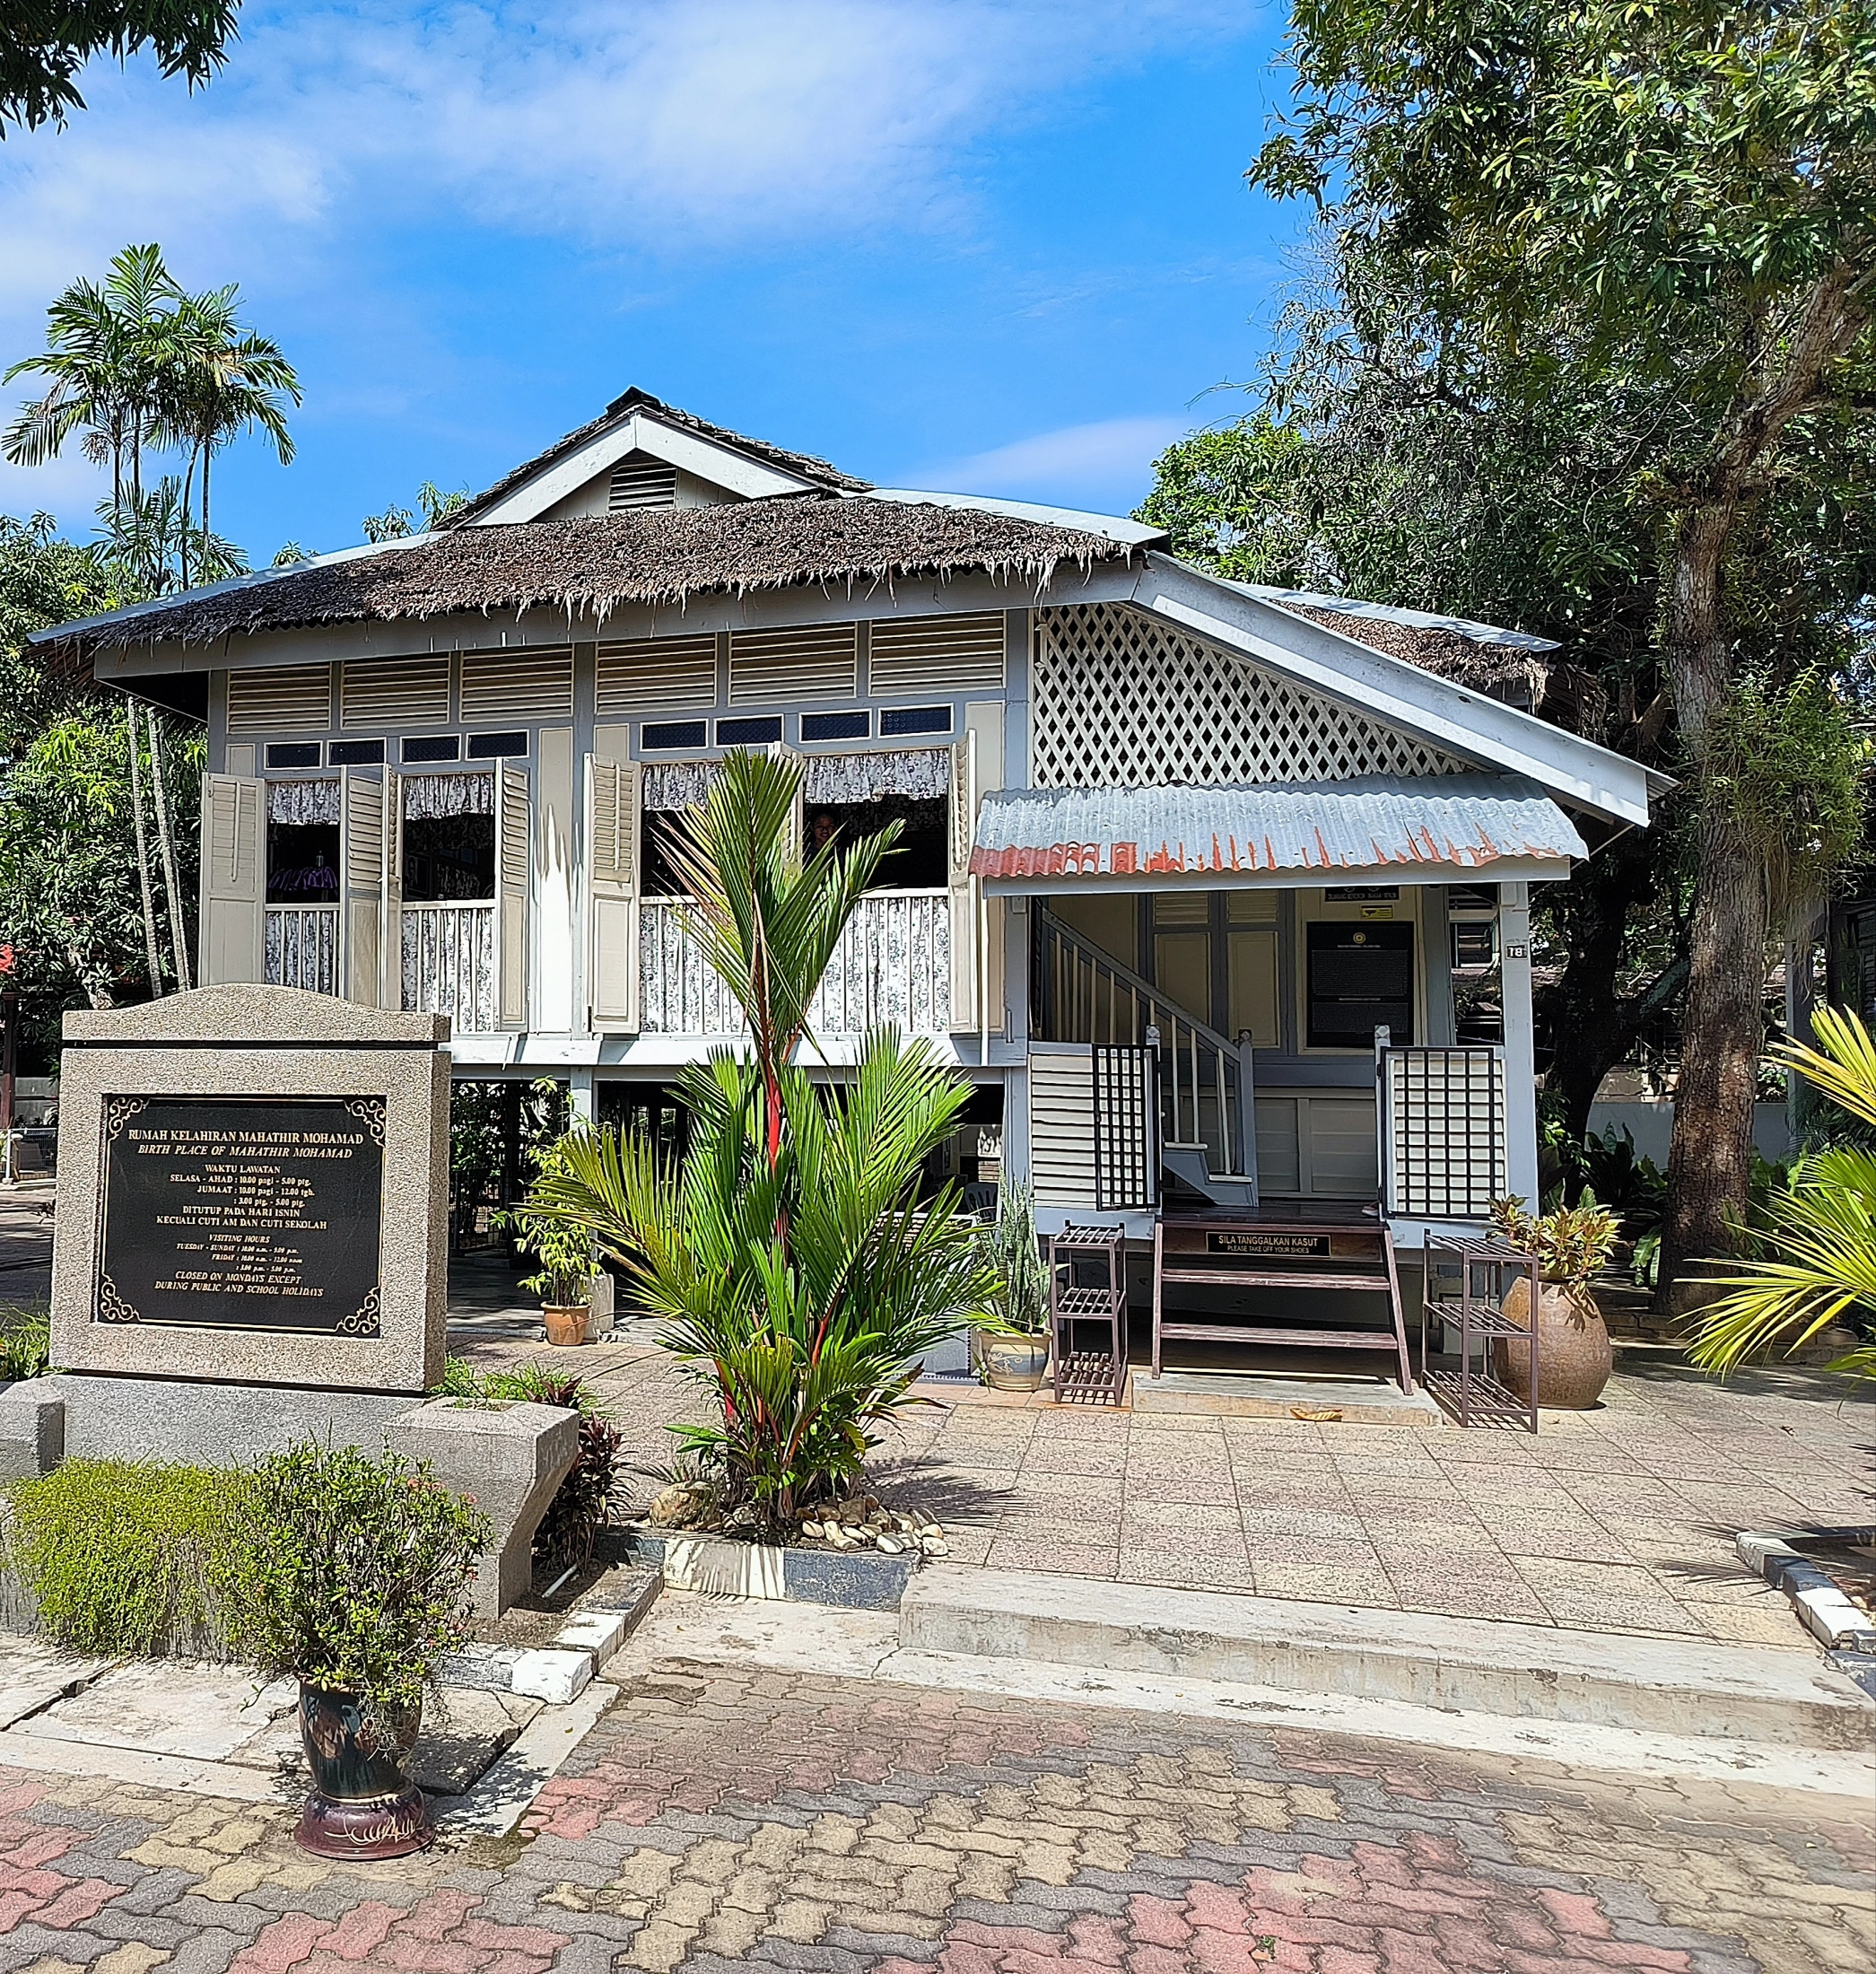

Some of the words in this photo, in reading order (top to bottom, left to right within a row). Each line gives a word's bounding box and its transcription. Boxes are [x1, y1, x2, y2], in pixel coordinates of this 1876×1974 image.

[128, 1130, 167, 1140] RUMAH
[170, 1131, 236, 1141] KELAHIRAN
[239, 1131, 300, 1143] MAHATHIR
[302, 1132, 364, 1144] MOHAMAD
[138, 1145, 170, 1154] BIRTH
[174, 1146, 207, 1155] PLACE
[211, 1147, 226, 1155] OF
[229, 1147, 291, 1157] MAHATHIR
[292, 1148, 353, 1158] MOHAMAD
[240, 1166, 280, 1174] LAWATAN
[170, 1175, 200, 1183] SELASA
[258, 1177, 274, 1185] pagi
[297, 1178, 311, 1186] ptg.
[257, 1187, 273, 1196] pagi
[301, 1189, 315, 1197] tgh.
[183, 1206, 222, 1215] DITUTUP
[224, 1207, 246, 1215] PADA
[248, 1208, 273, 1217] HARI
[275, 1209, 301, 1218] ISNIN
[156, 1215, 196, 1225] KECUALI
[198, 1217, 220, 1226] CUTI
[223, 1218, 237, 1226] AM
[240, 1218, 258, 1227] DAN
[260, 1218, 283, 1228] CUTI
[285, 1219, 327, 1229] SEKOLAH
[209, 1234, 242, 1242] VISITING
[244, 1235, 270, 1244] HOURS
[1218, 1236, 1236, 1244] SILA
[1237, 1236, 1289, 1245] TANGGALKAN
[1292, 1238, 1318, 1246] KASUT
[175, 1271, 207, 1280] CLOSED
[210, 1272, 223, 1281] ON
[225, 1273, 266, 1283] MONDAYS
[267, 1275, 301, 1284] EXCEPT
[154, 1280, 188, 1290] DURING
[191, 1283, 221, 1291] PUBLIC
[224, 1284, 243, 1292] AND
[246, 1286, 279, 1294] SCHOOL
[282, 1287, 324, 1297] HOLIDAYS
